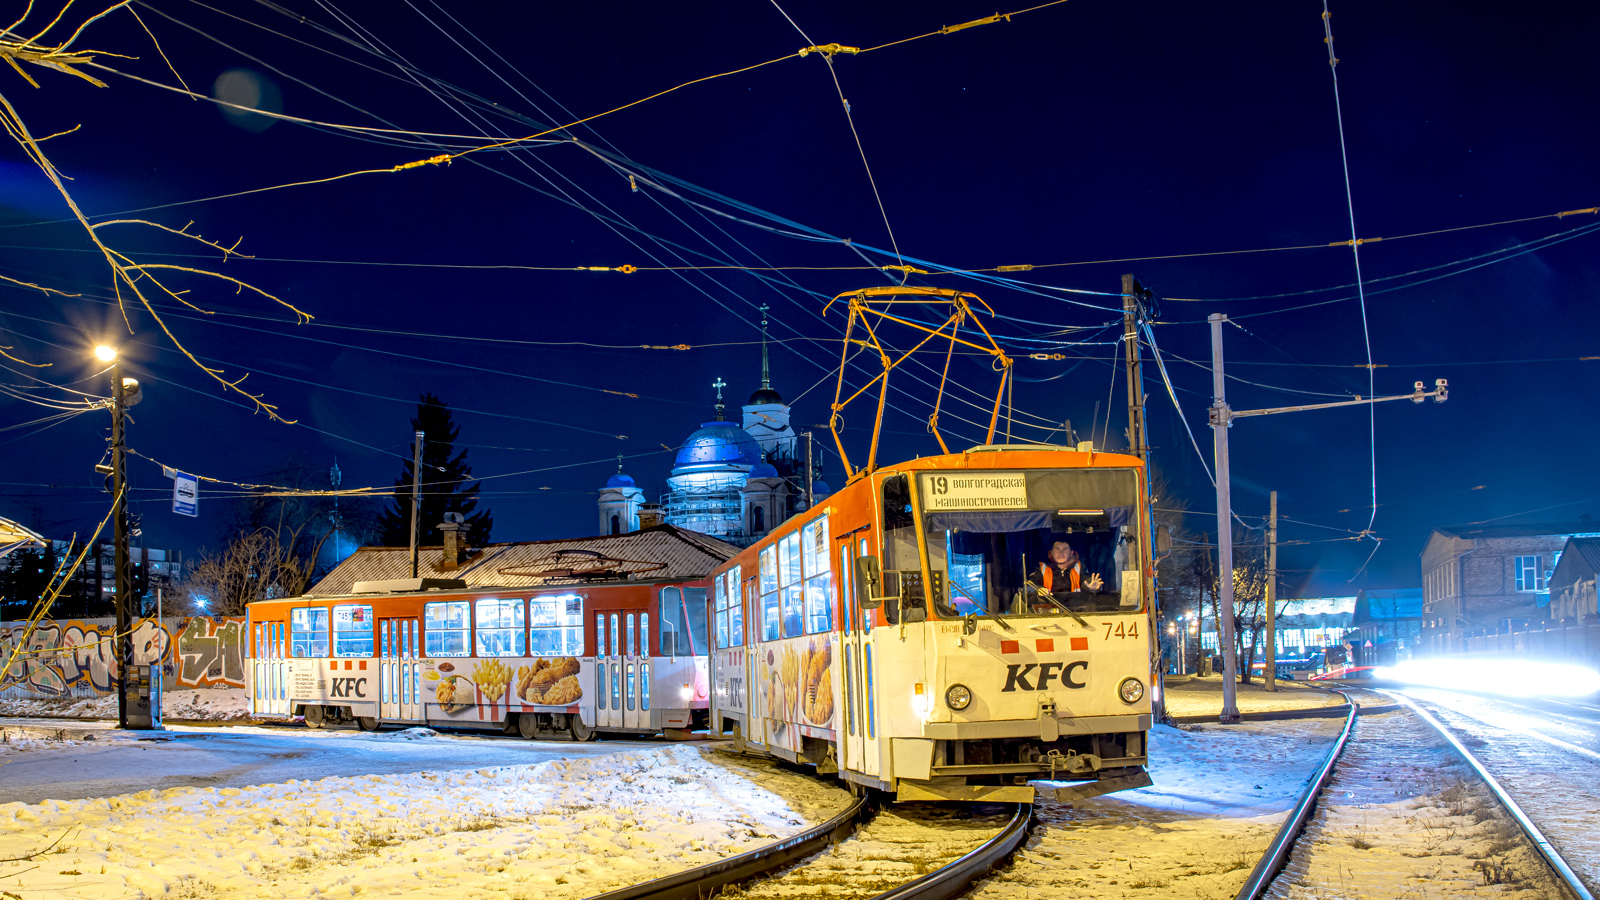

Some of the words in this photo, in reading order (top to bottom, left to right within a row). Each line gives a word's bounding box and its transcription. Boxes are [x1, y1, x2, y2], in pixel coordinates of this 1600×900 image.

[930, 477, 949, 495] 19
[1101, 621, 1139, 641] 744
[1001, 661, 1089, 692] KFC
[330, 677, 368, 698] KFC
